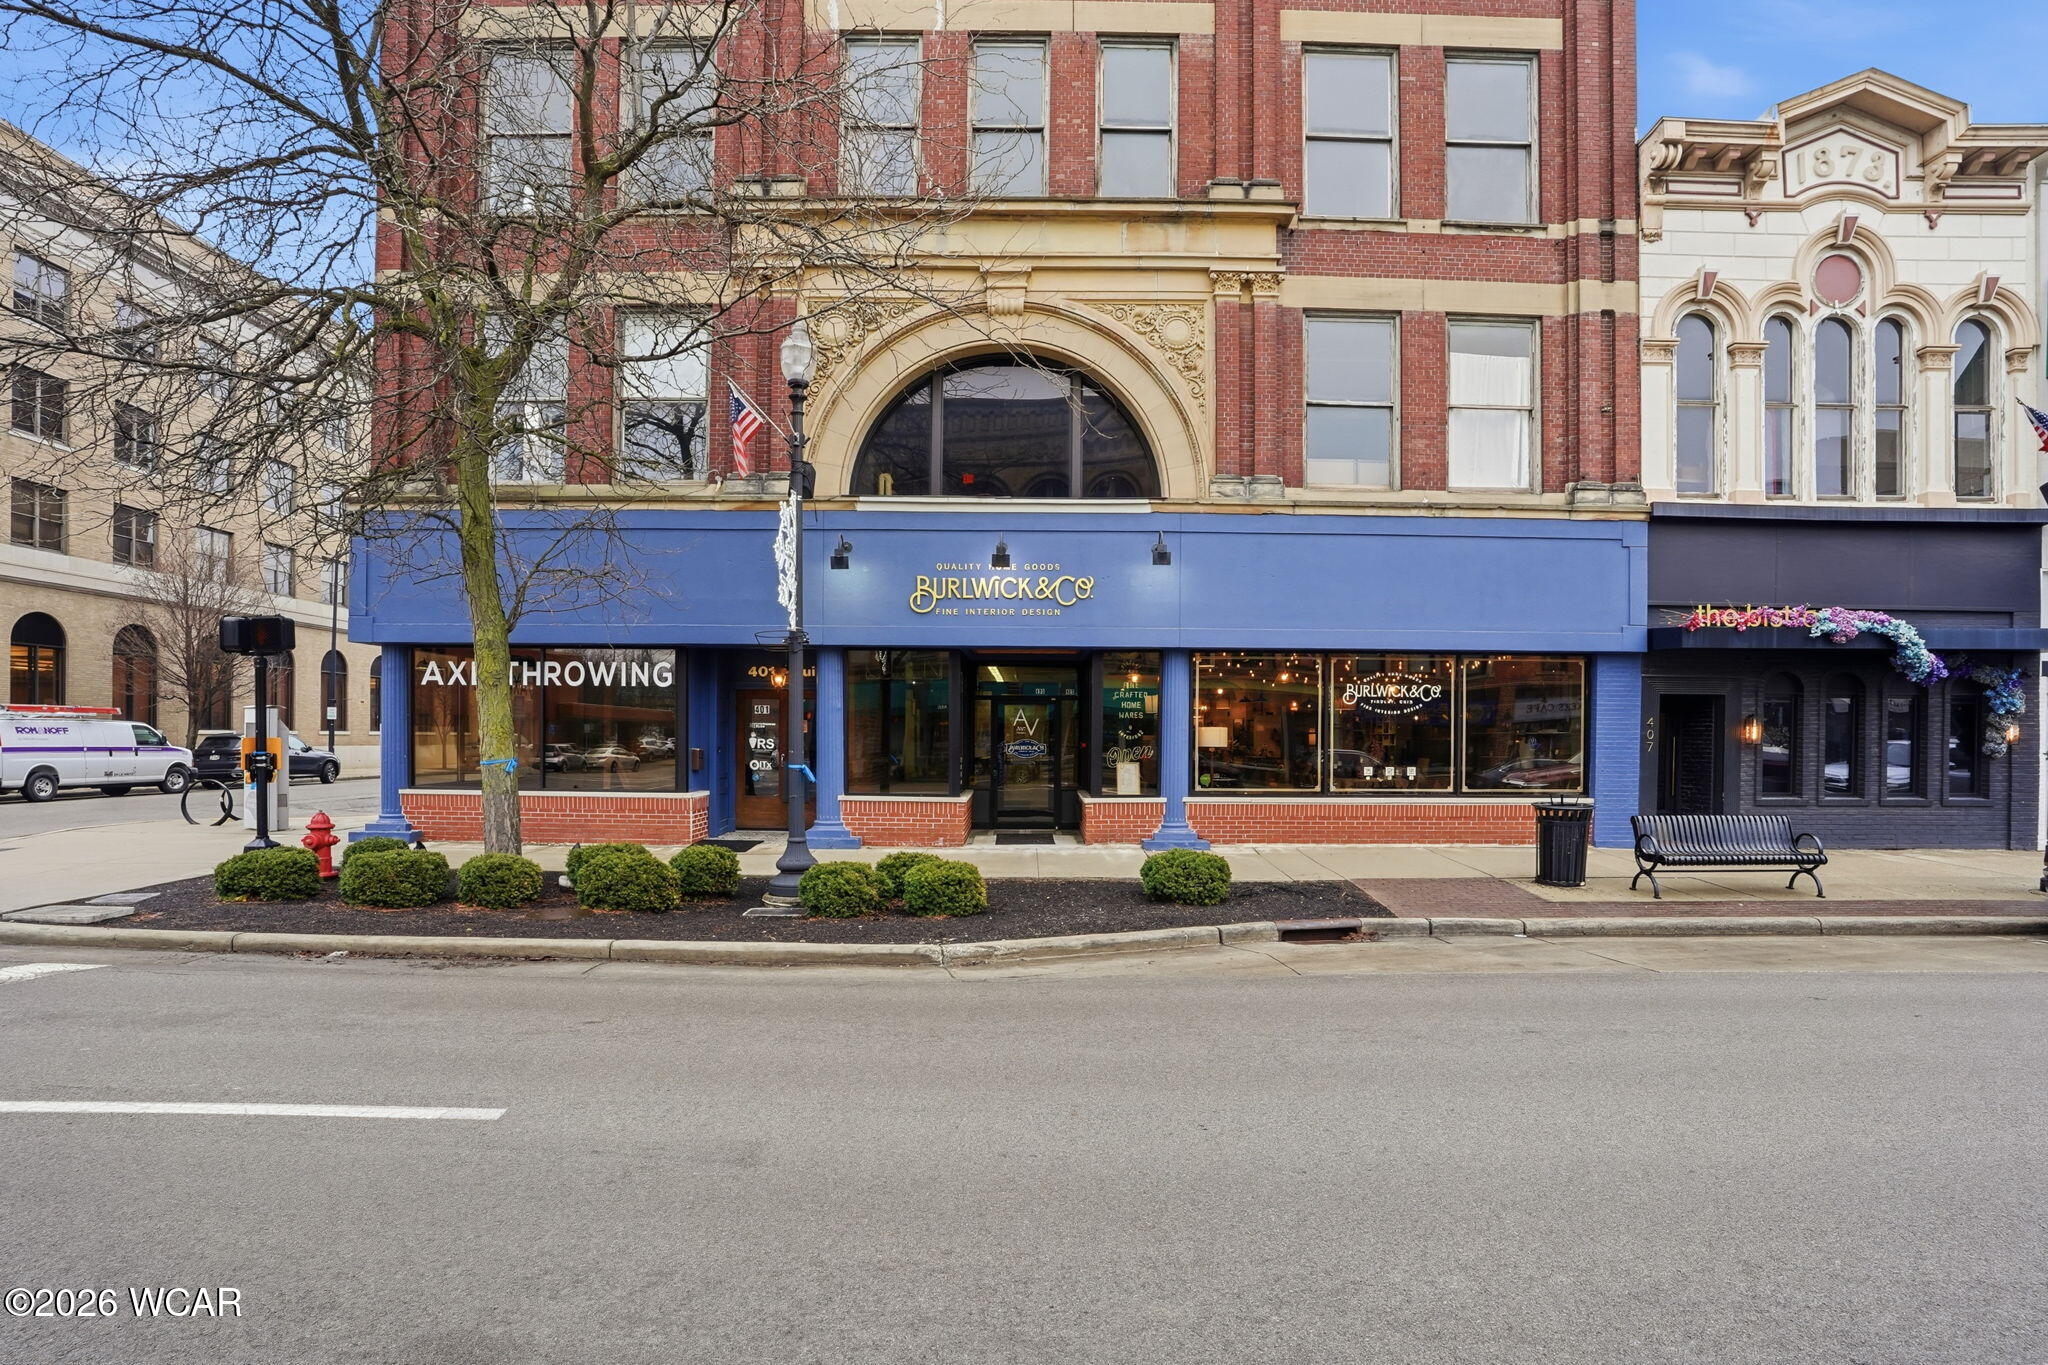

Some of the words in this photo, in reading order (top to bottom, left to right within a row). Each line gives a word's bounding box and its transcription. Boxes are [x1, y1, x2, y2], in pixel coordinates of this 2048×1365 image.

[936, 563, 981, 571] QUALITY
[1024, 563, 1061, 571] GOODS
[935, 608, 958, 616] FINE
[965, 608, 1016, 616] INTERIOR
[1021, 608, 1061, 616] DESIGN
[1696, 603, 1738, 628] the
[1747, 603, 1820, 628] bisto
[754, 705, 770, 714] 401
